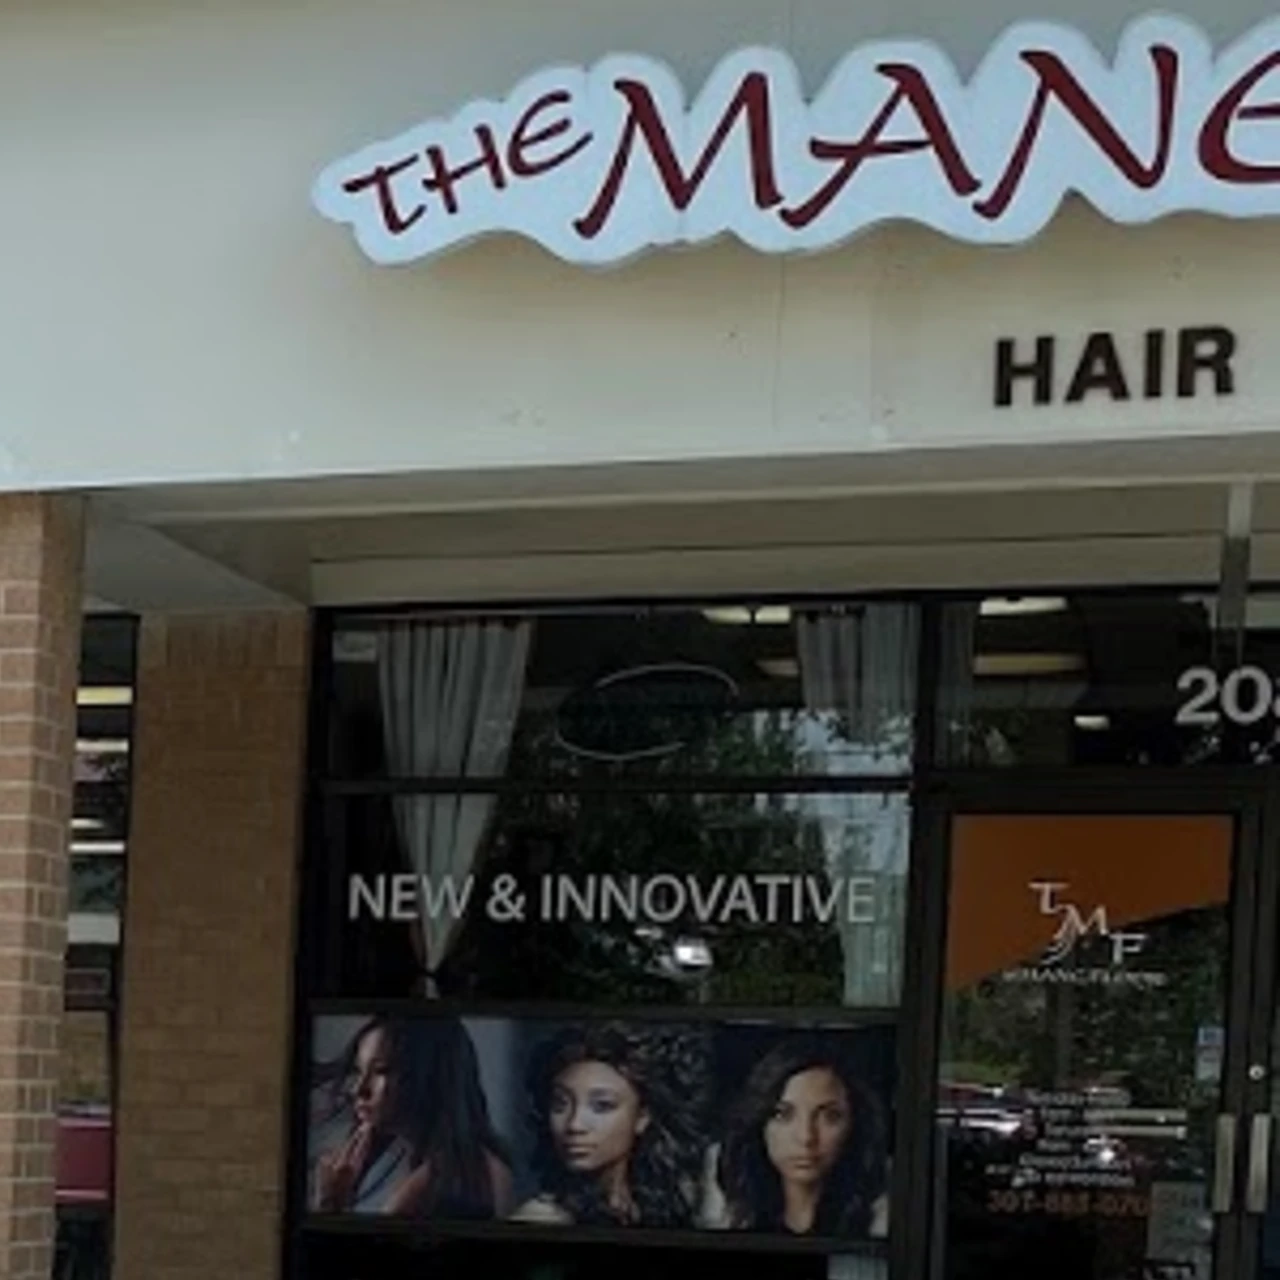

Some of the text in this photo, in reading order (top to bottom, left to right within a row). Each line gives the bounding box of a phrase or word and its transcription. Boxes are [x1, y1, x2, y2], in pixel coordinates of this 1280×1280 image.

[343, 90, 594, 234] THE
[991, 325, 1237, 407] HAIR
[1175, 665, 1280, 725] 20
[348, 873, 878, 924] NEW & INNOVATIVE
